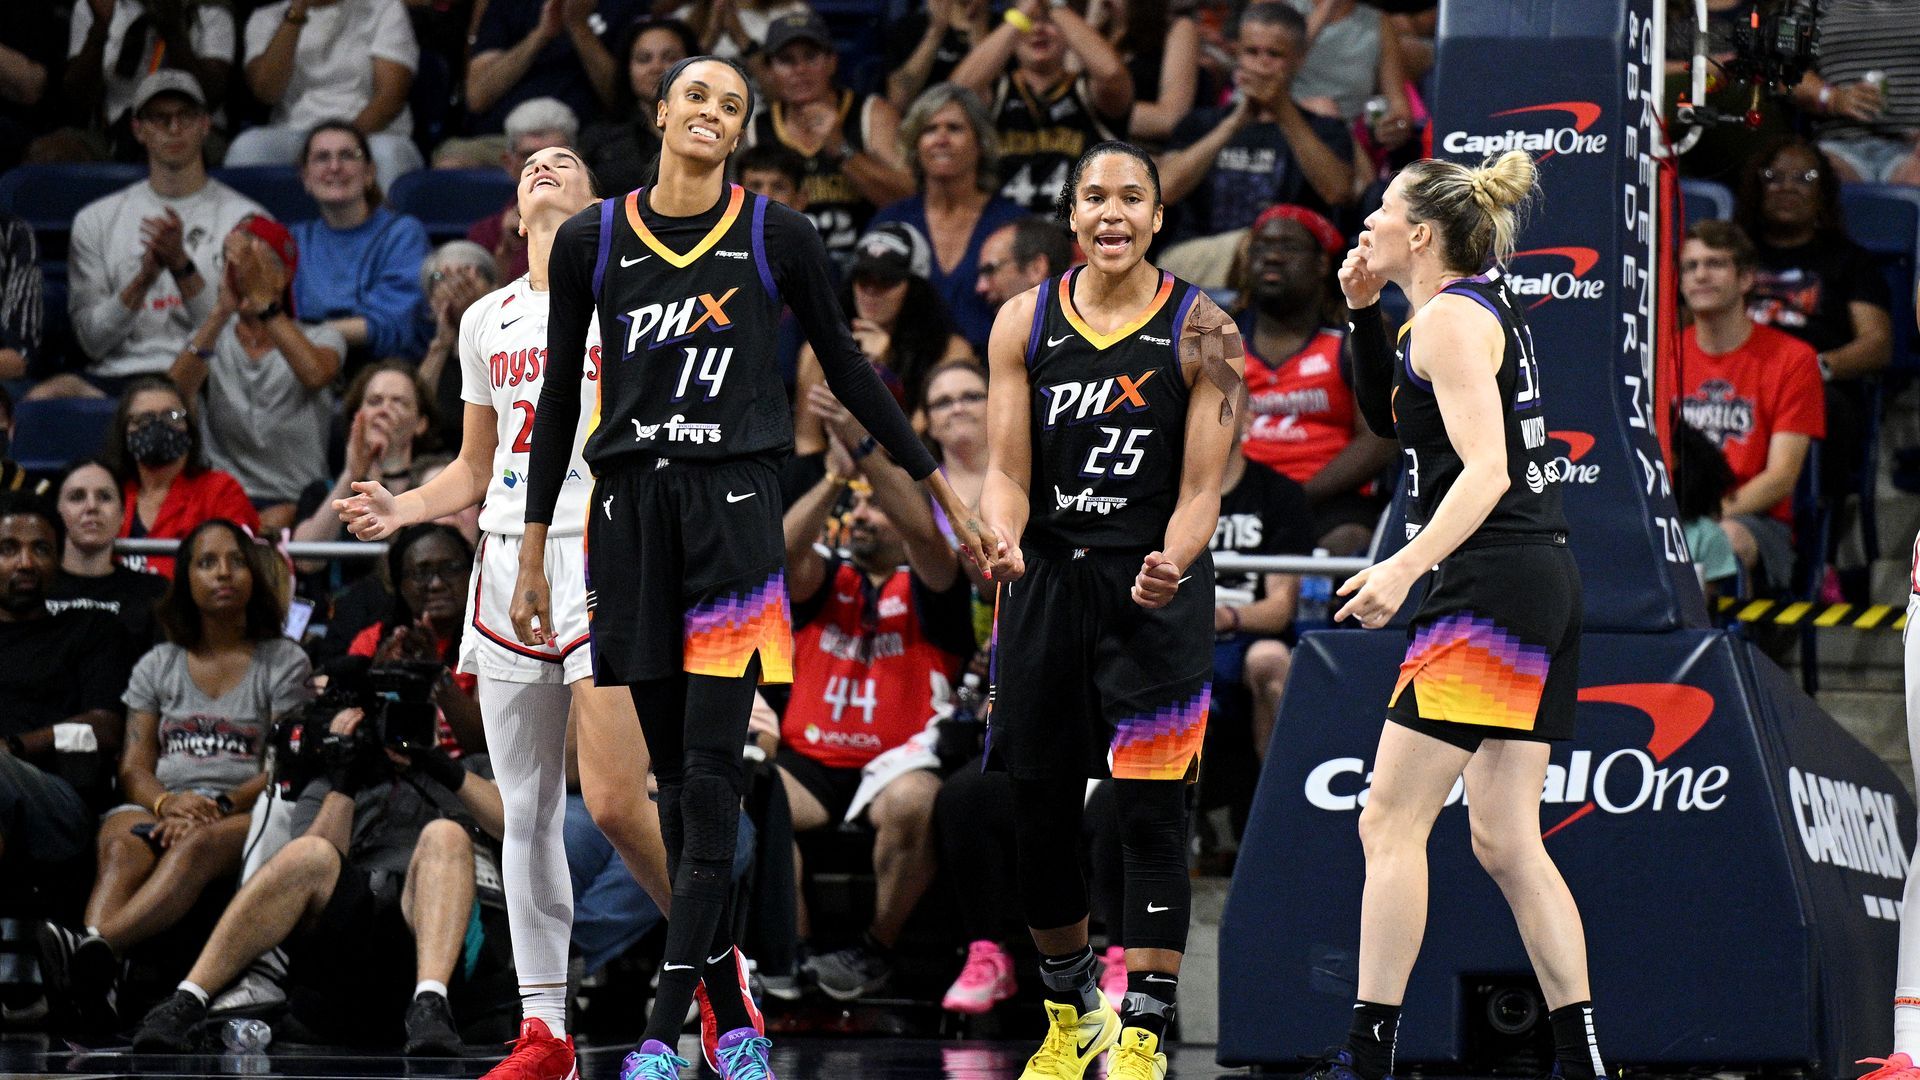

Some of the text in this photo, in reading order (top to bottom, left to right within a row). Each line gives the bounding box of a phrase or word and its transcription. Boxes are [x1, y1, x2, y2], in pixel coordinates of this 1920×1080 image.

[618, 287, 740, 359] PHX
[673, 347, 734, 400] 14
[1041, 370, 1156, 429] PHX
[1081, 426, 1154, 477] 25
[1404, 447, 1420, 498] 3
[823, 675, 877, 724] 44
